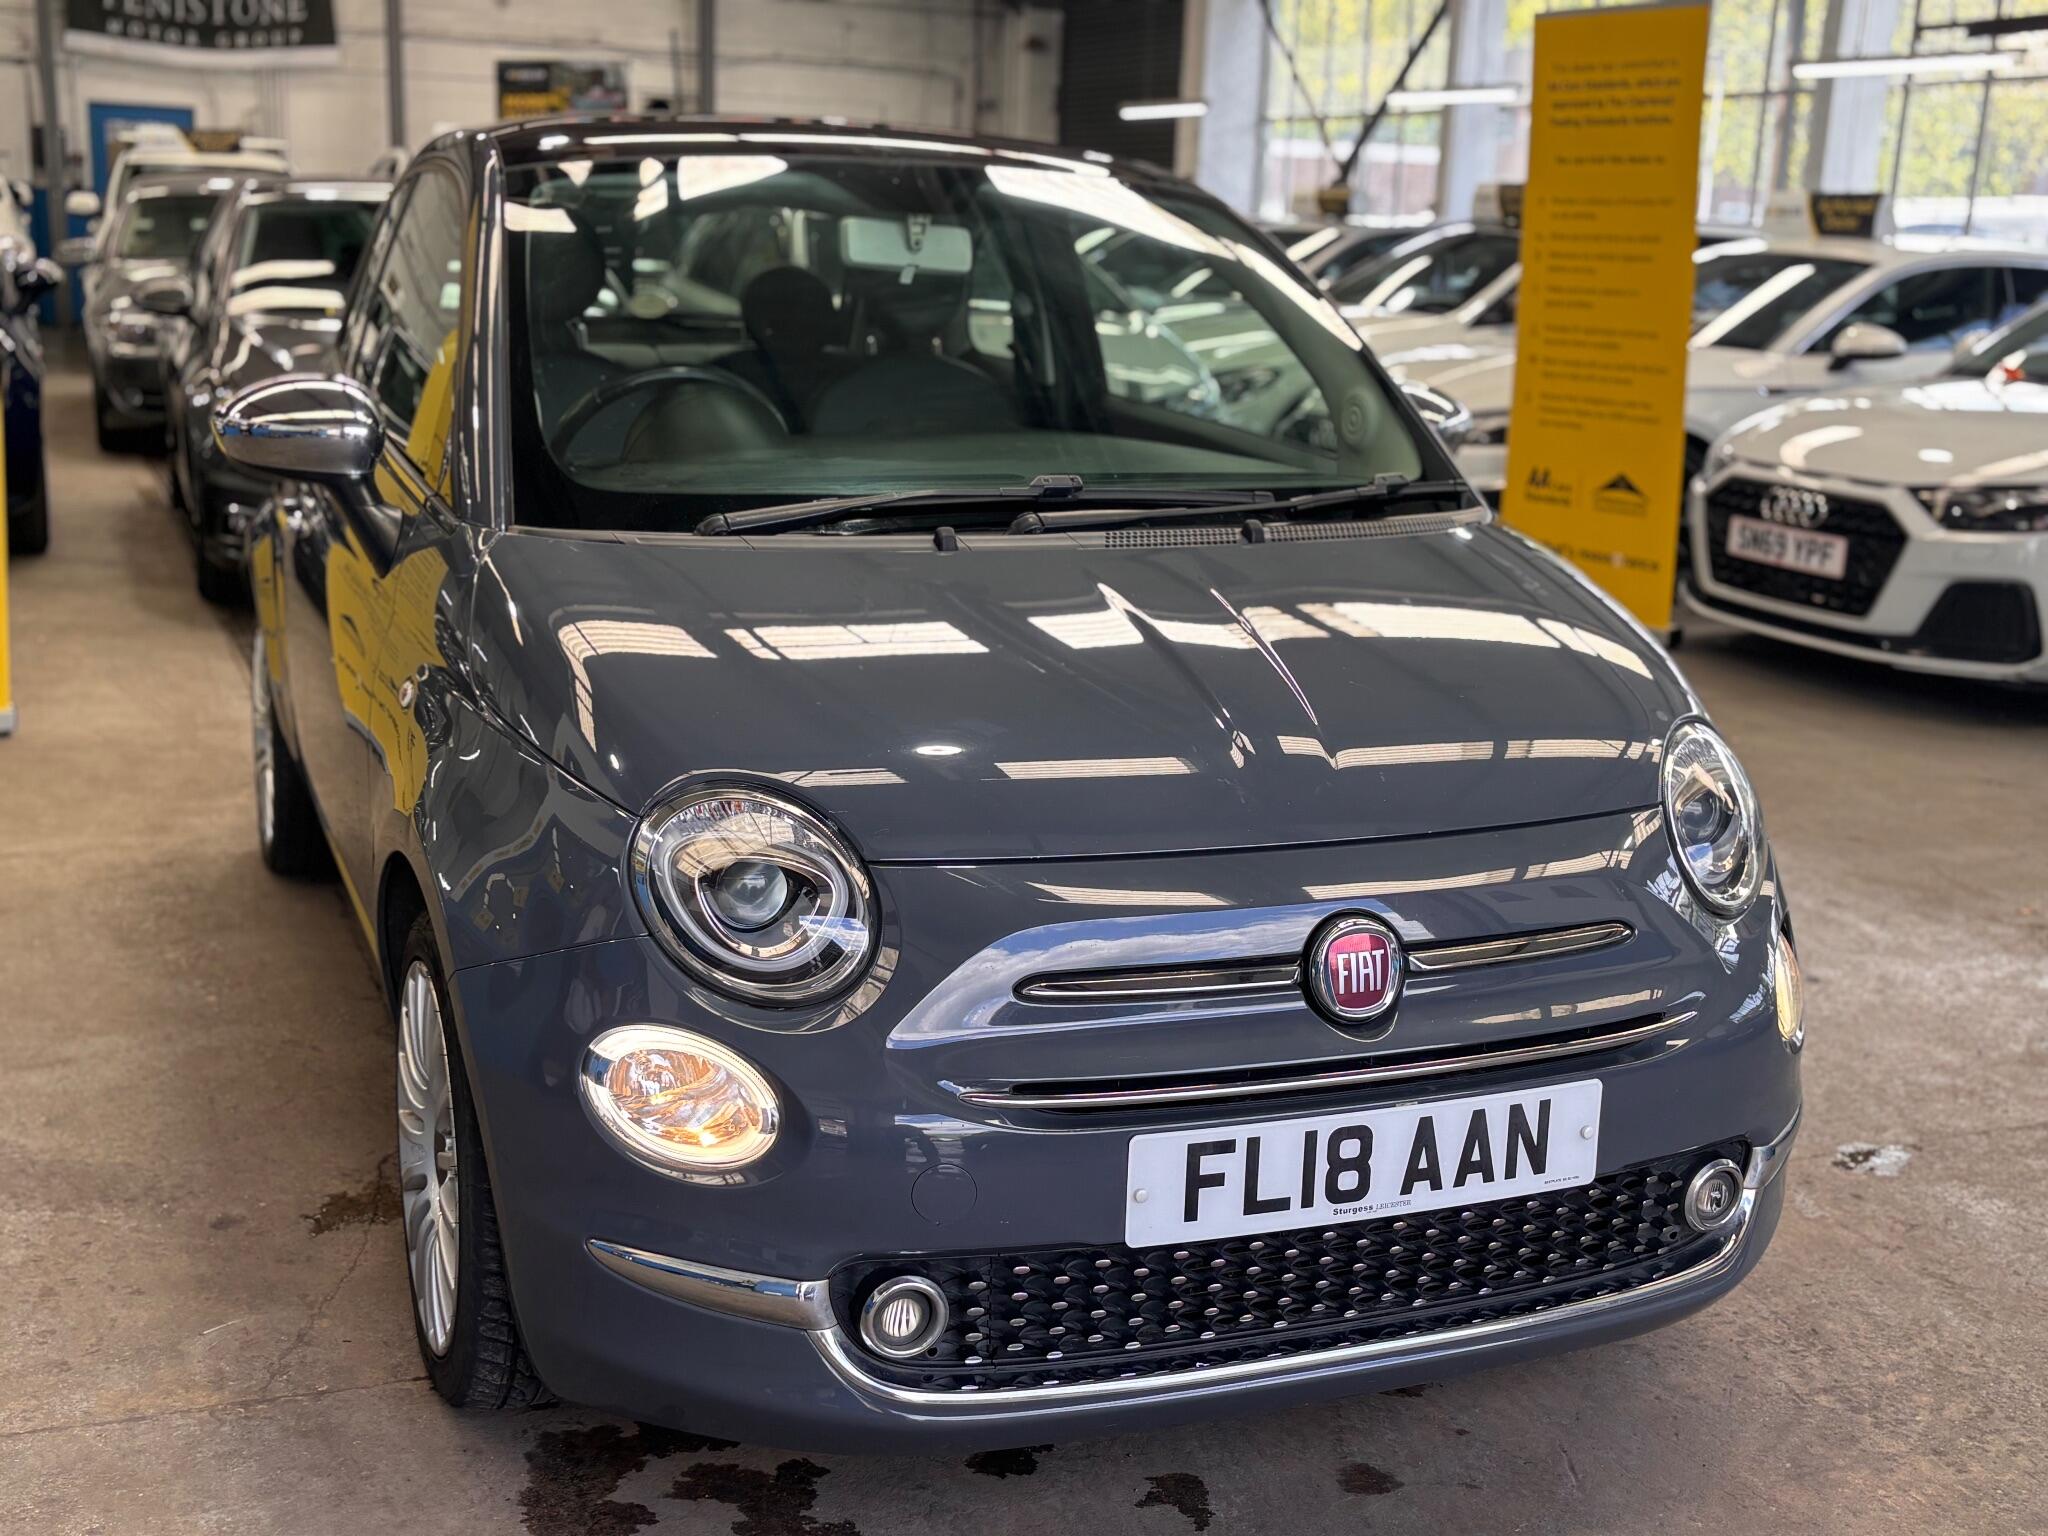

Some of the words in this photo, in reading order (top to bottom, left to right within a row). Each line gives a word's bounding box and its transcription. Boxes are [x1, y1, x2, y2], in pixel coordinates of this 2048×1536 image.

[214, 28, 303, 49] GROUP
[1337, 949, 1384, 994] FIAT
[1184, 1125, 1373, 1222] FL18
[1400, 1099, 1551, 1196] AAN
[1333, 1204, 1374, 1216] Sturgess
[1376, 1199, 1412, 1210] LEICESTER
